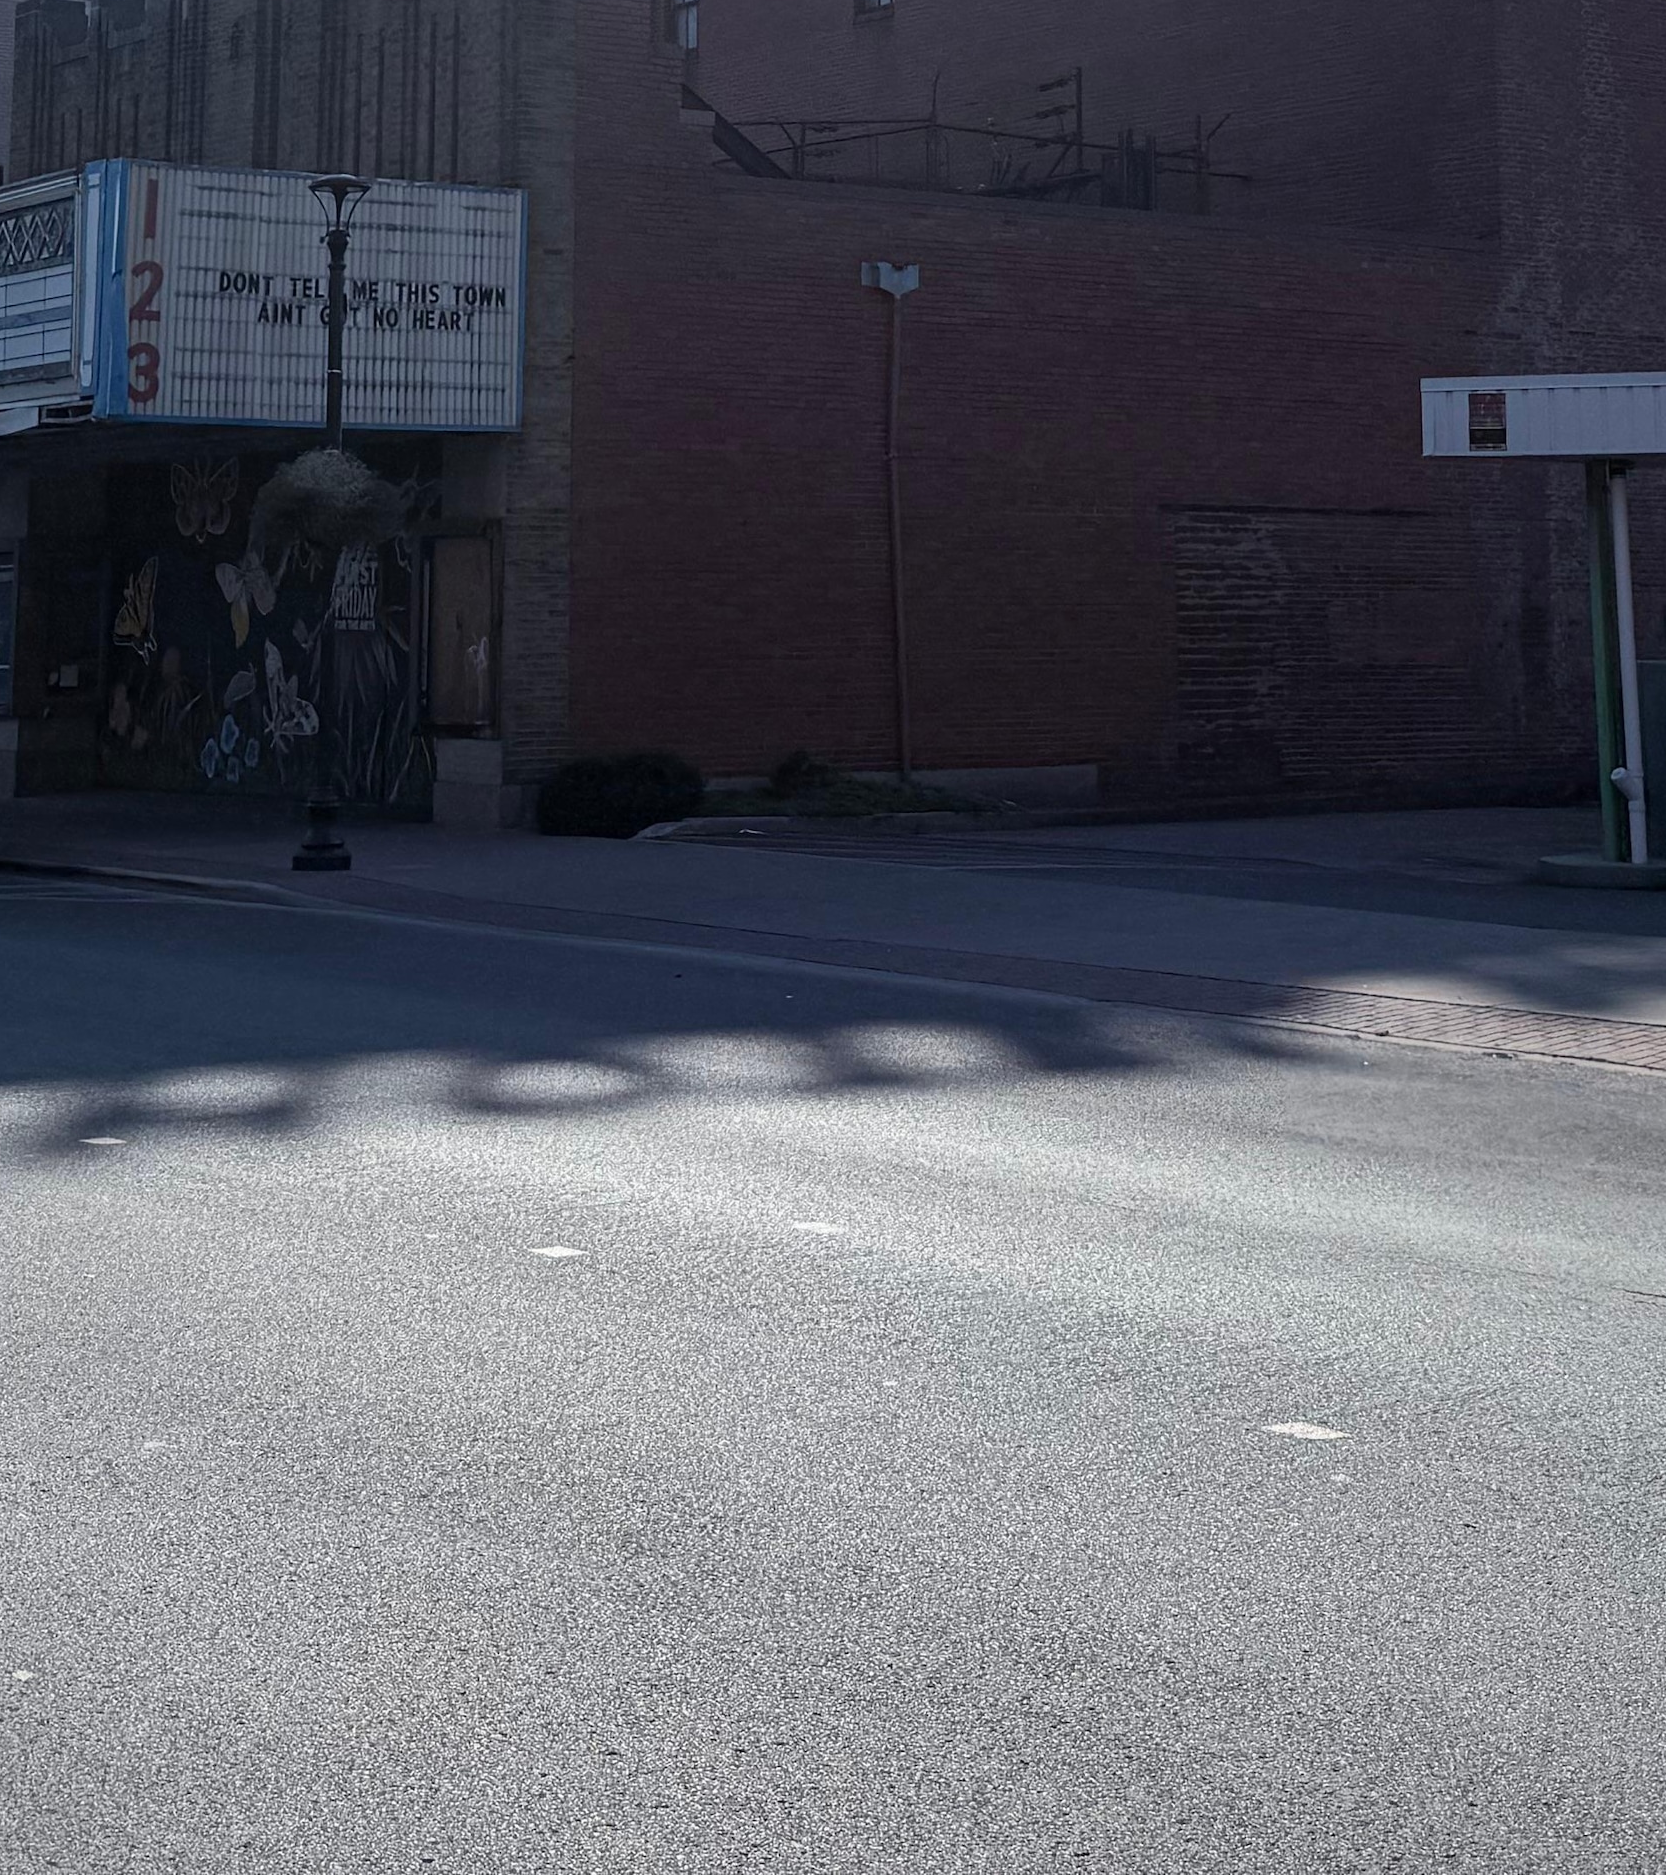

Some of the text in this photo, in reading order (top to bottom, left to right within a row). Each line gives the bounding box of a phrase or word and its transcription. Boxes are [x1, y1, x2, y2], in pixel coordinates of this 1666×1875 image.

[129, 260, 164, 322] 2
[219, 271, 506, 307] DONT TEL ME THIS TOWN
[258, 303, 474, 331] AINT GT NO HEART
[128, 342, 161, 403] 3
[334, 586, 377, 619] FRIDAY
